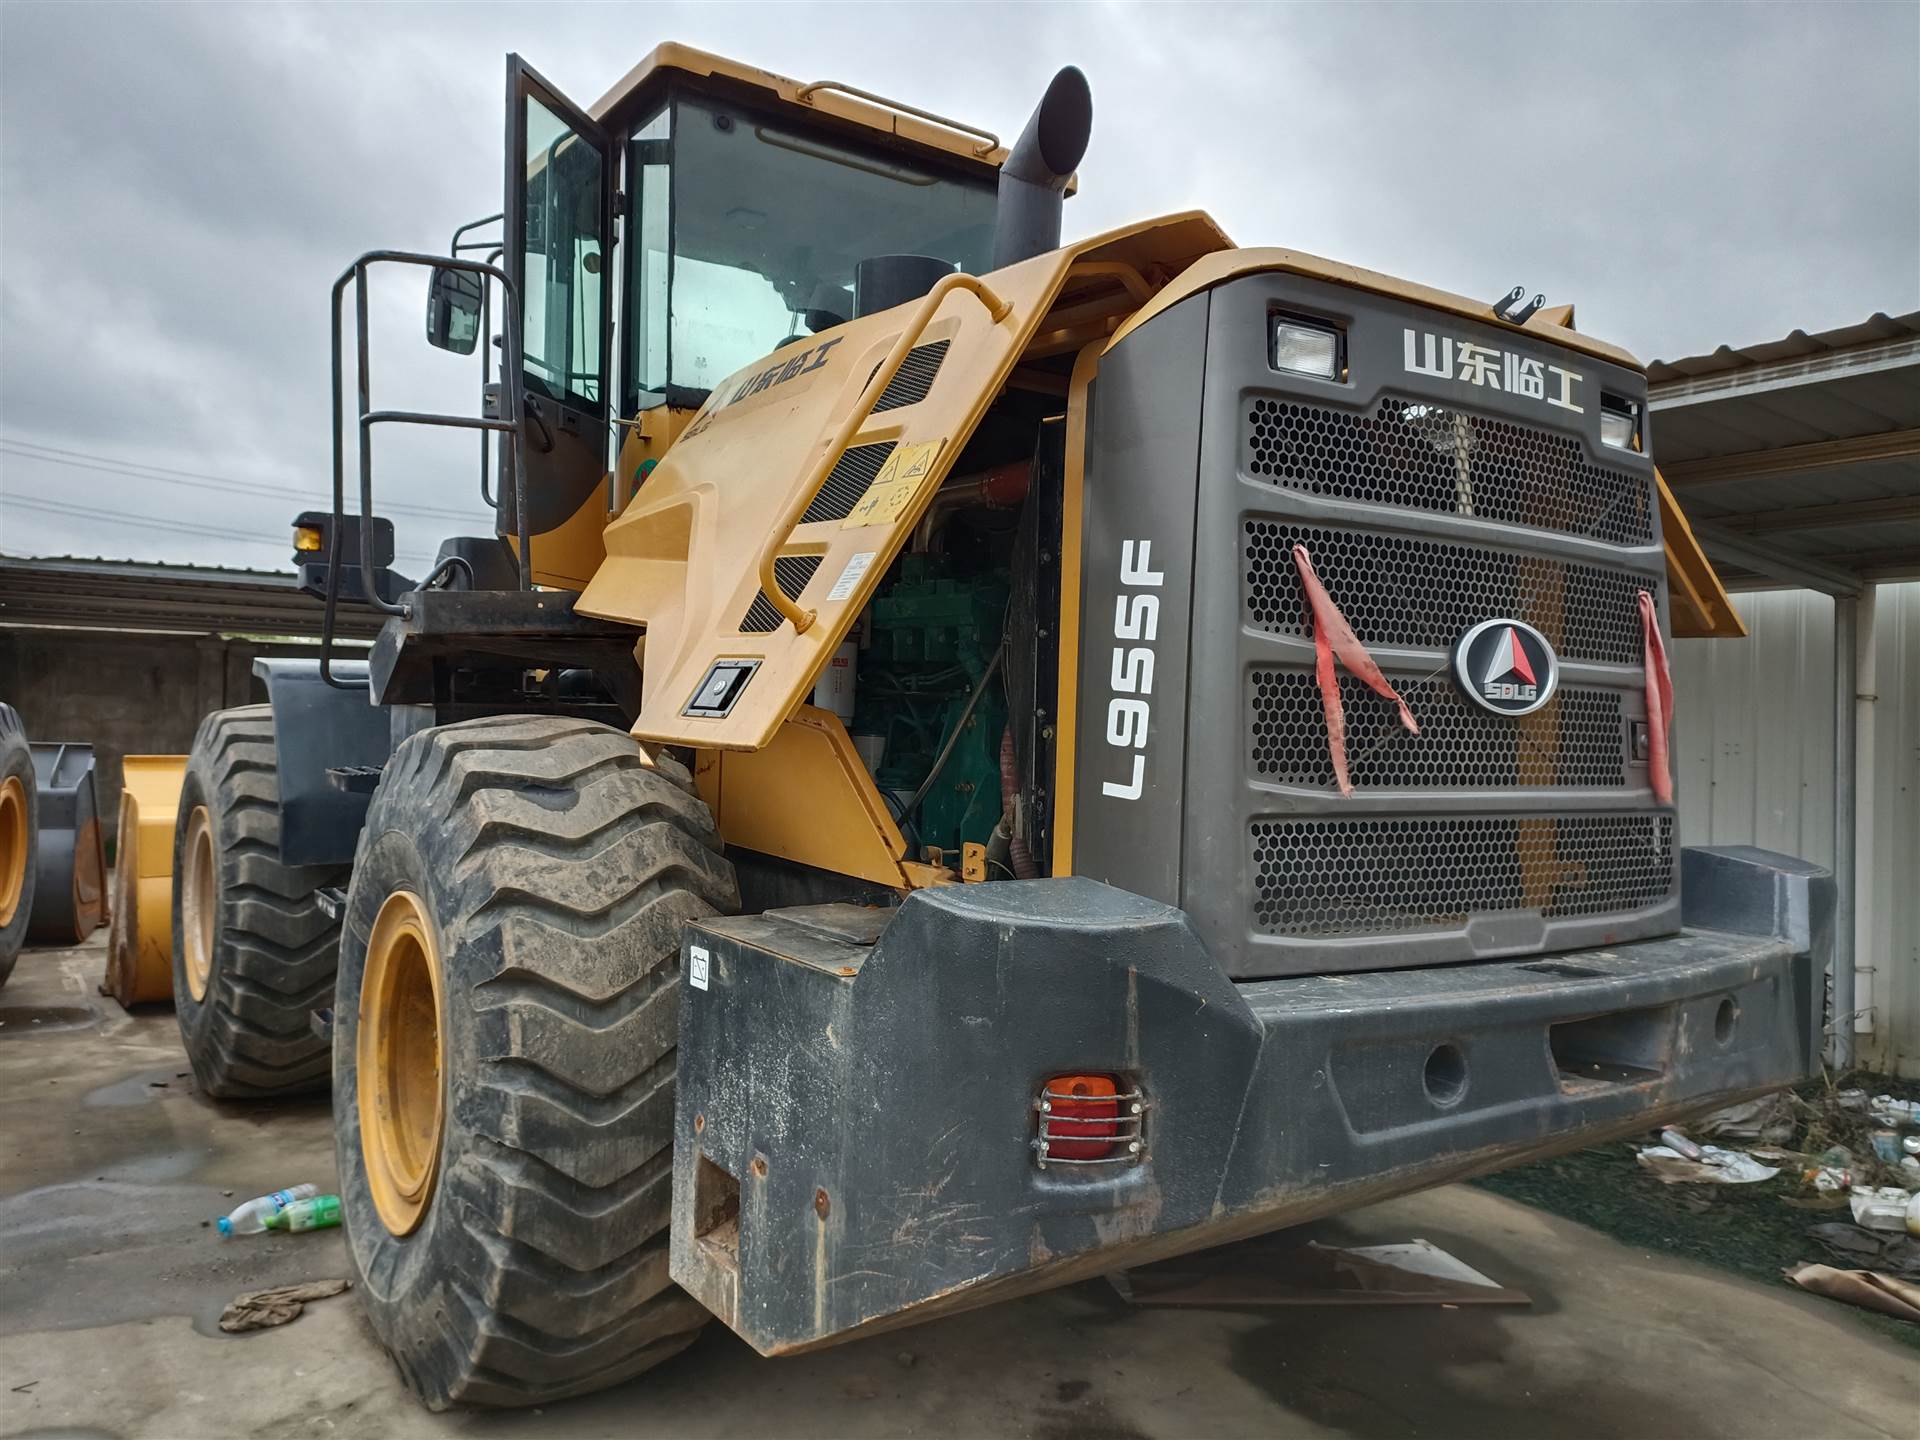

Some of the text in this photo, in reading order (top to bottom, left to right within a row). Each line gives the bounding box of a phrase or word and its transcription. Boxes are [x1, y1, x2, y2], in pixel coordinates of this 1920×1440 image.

[727, 336, 844, 406] 山东临工
[1403, 328, 1584, 414] 山东临工
[1102, 540, 1164, 801] L955F
[1484, 683, 1537, 701] SDLG
